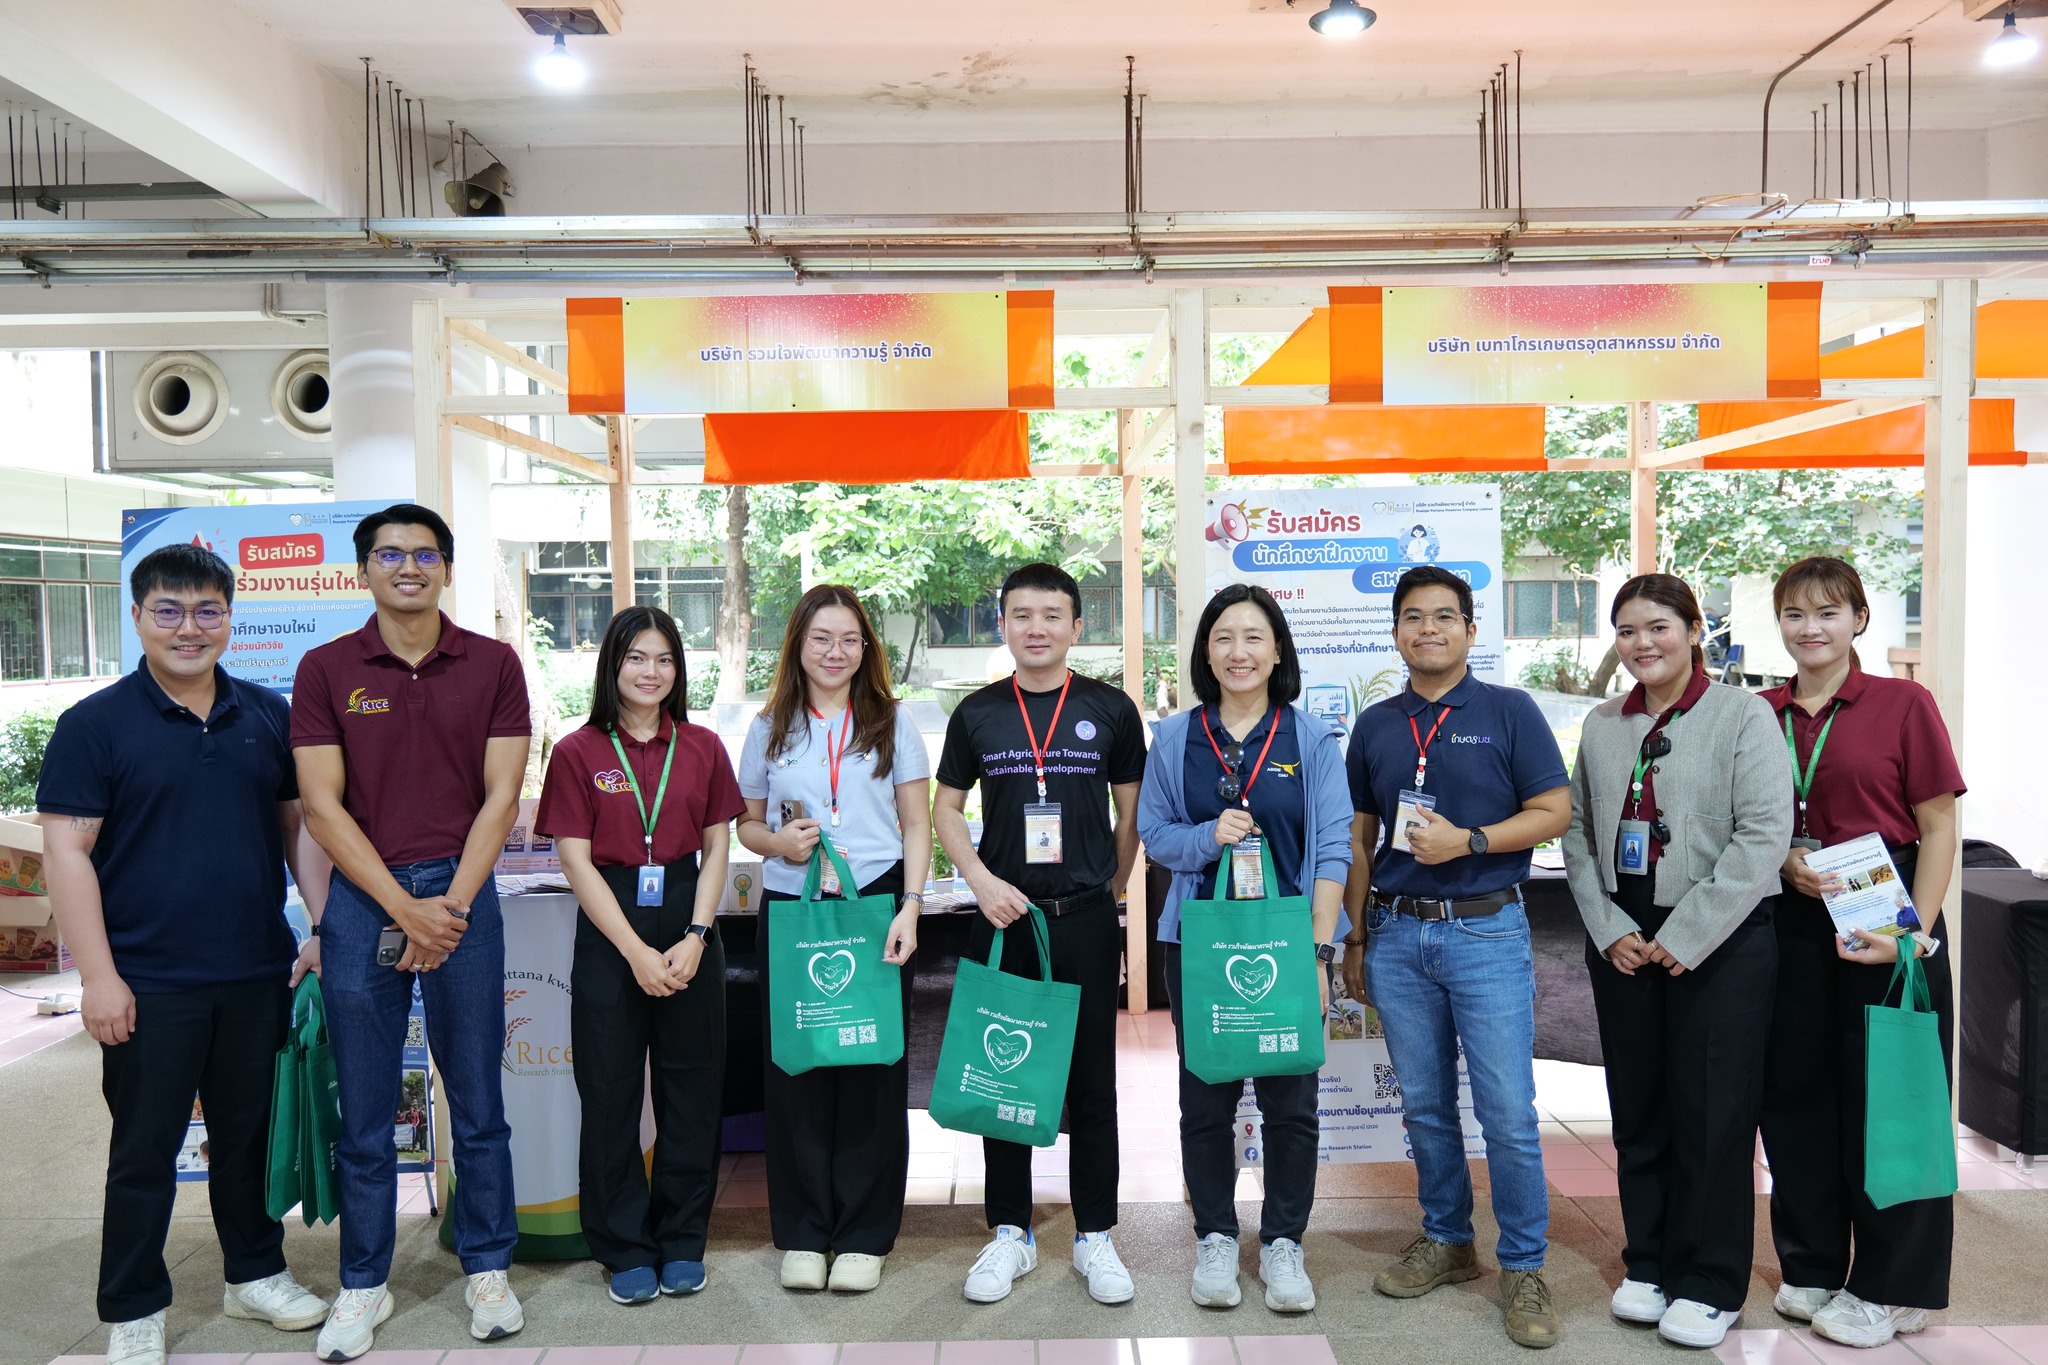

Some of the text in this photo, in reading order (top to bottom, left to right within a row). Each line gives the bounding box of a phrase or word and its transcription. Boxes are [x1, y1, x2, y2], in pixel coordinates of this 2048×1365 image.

[700, 342, 932, 363] บริษัท รวมใจพัฒนาความรู้ จำกัด
[1428, 333, 1721, 355] บริษัท เบทาโกรเกษตรอุตสาหกรรม จำกัด
[1267, 508, 1361, 534] รับสมัคร
[247, 542, 317, 562] รับสมัคร
[1252, 541, 1388, 566] นักศึกษาฝึกงาน
[233, 605, 294, 615] ละปรับปรุงพันธุ์ข้าว
[230, 619, 316, 636] กศึกษาจบใหม่
[362, 701, 389, 710] Rice
[982, 748, 1101, 762] Smart Agriclure Towards
[985, 764, 1097, 776] Sustainable evelopment
[547, 974, 572, 995] kwa
[552, 1068, 574, 1076] Statio
